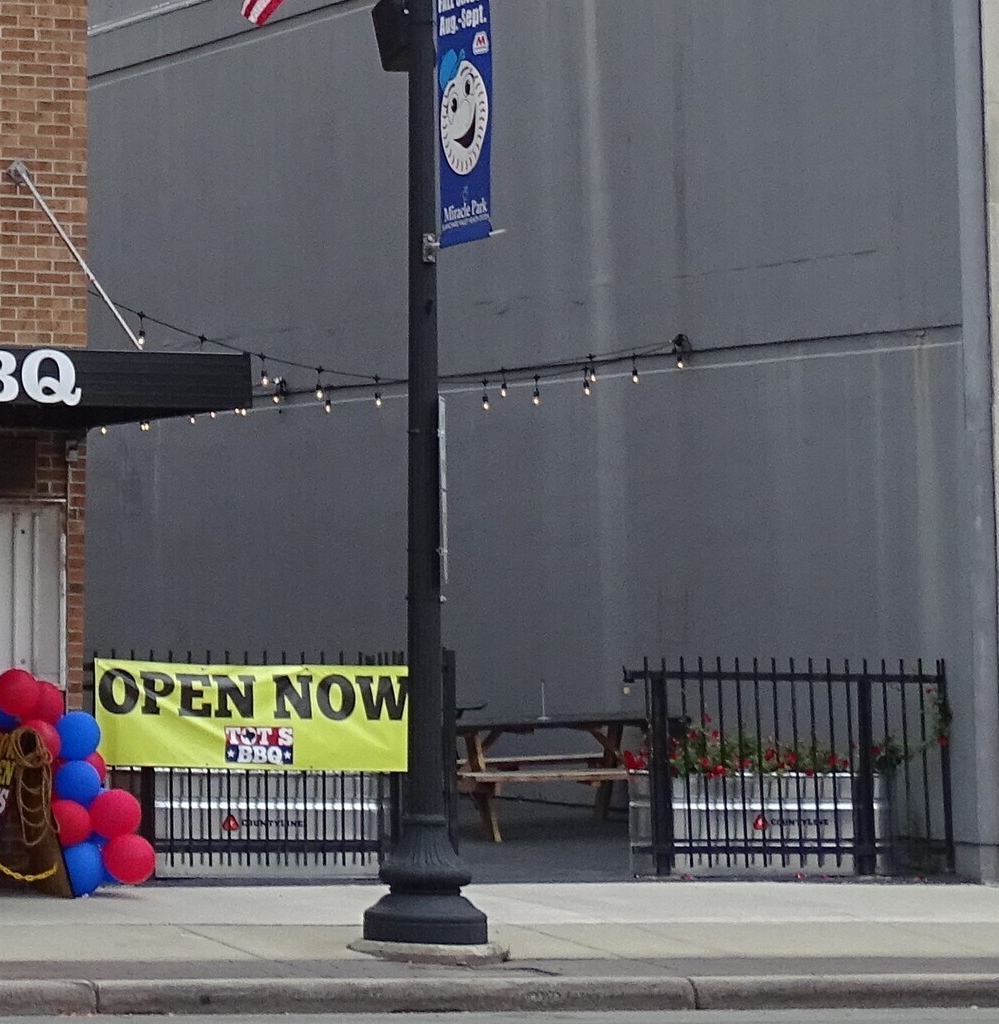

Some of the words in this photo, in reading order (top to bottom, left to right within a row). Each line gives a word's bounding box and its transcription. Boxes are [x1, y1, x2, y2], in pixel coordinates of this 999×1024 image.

[443, 202, 471, 223] Miracle
[471, 197, 488, 216] Park
[98, 668, 256, 719] OPEN
[273, 674, 408, 720] NOW
[237, 745, 283, 765] BBQ
